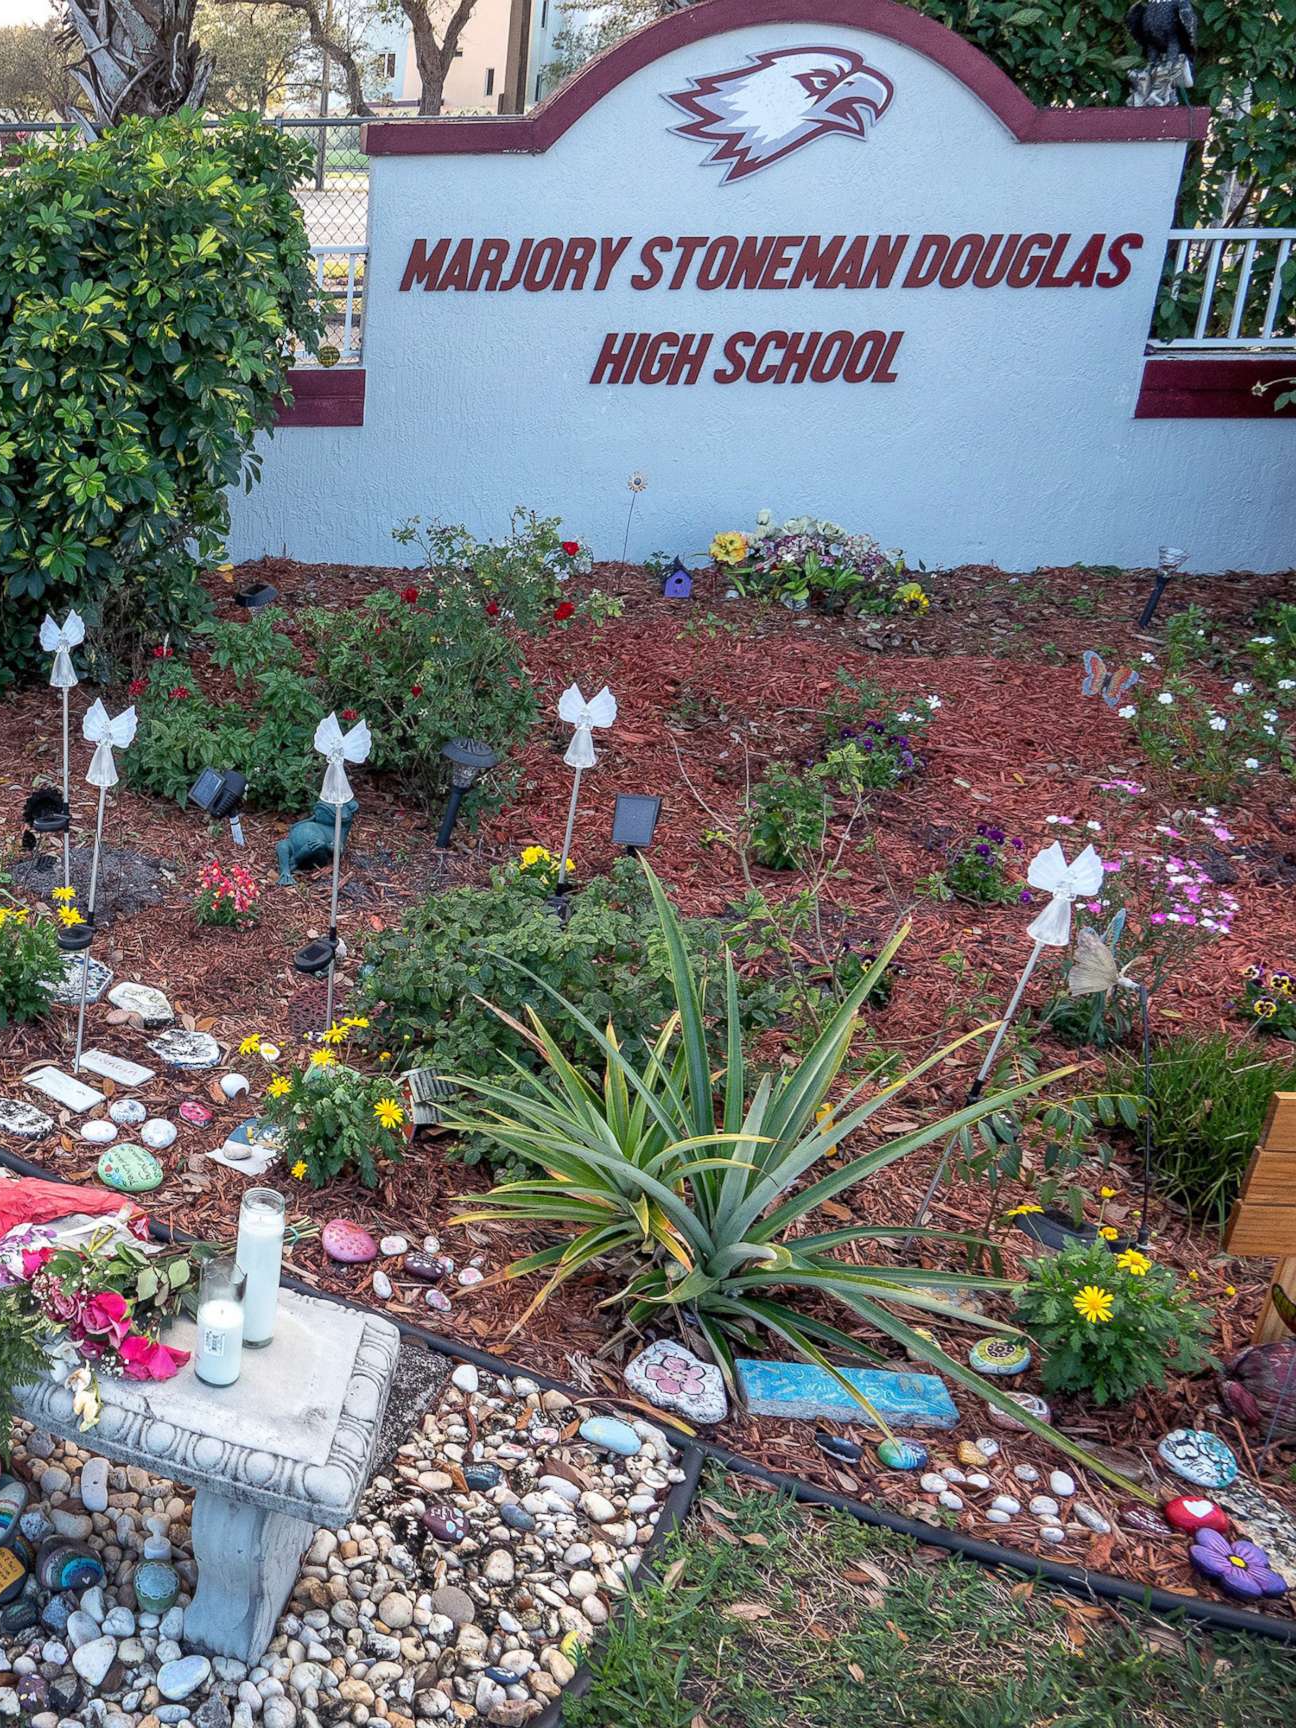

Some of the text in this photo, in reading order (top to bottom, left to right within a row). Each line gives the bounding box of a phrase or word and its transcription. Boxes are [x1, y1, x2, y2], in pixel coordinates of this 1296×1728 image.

[400, 233, 1144, 291] MARJORY STONEMAN DOUGLAS
[590, 330, 905, 386] HIGH SCHOOL
[1182, 1461, 1218, 1481] Hope
